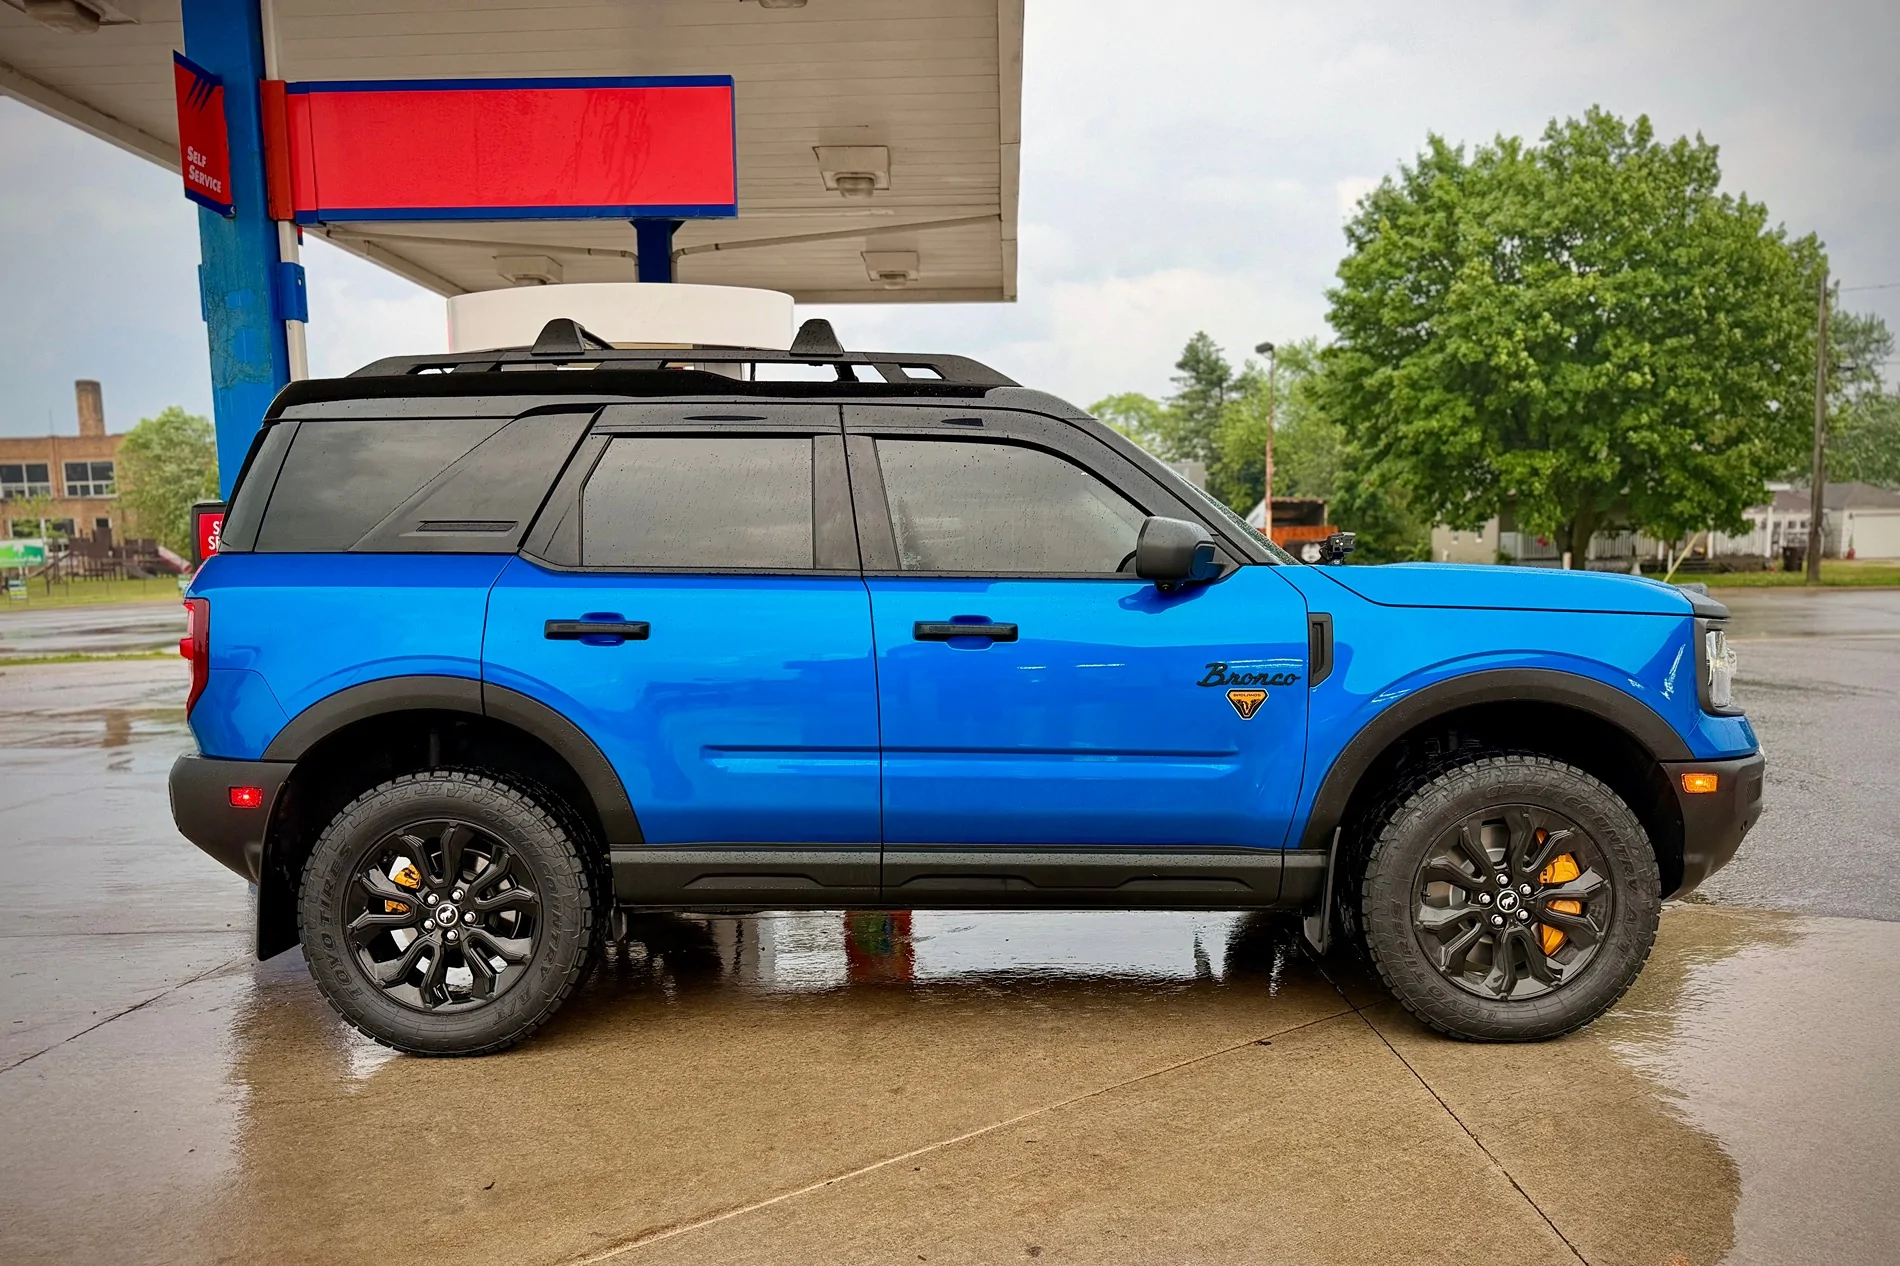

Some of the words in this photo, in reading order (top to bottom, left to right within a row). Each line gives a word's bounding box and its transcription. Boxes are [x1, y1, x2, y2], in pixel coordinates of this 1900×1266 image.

[187, 146, 206, 167] SELF
[188, 164, 222, 193] SERVICE
[212, 520, 222, 535] S
[1196, 662, 1302, 687] Bronco
[1563, 793, 1638, 895] COUNTRY
[319, 841, 353, 926] TIRES
[539, 859, 563, 983] COUNTRY
[319, 930, 362, 1001] TOYO
[1426, 982, 1497, 1023] TOYO
